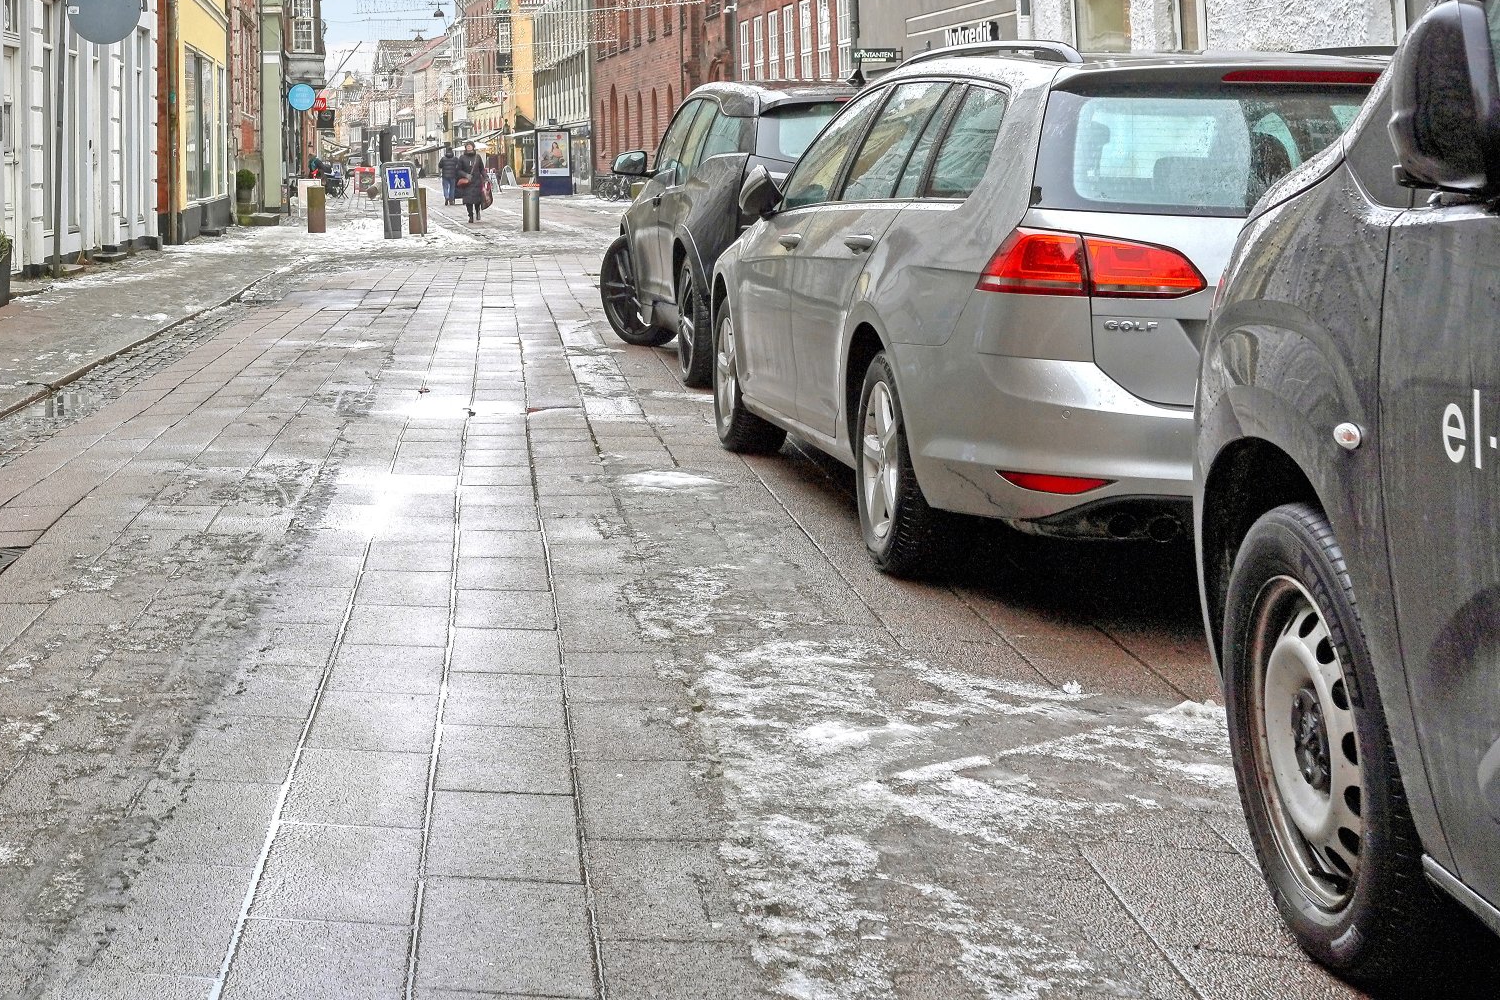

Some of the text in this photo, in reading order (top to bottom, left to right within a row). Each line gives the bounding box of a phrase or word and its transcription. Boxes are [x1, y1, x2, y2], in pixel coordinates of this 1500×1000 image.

[945, 21, 992, 47] Nykredit
[1103, 319, 1159, 332] GOLF
[1443, 388, 1498, 470] el-
